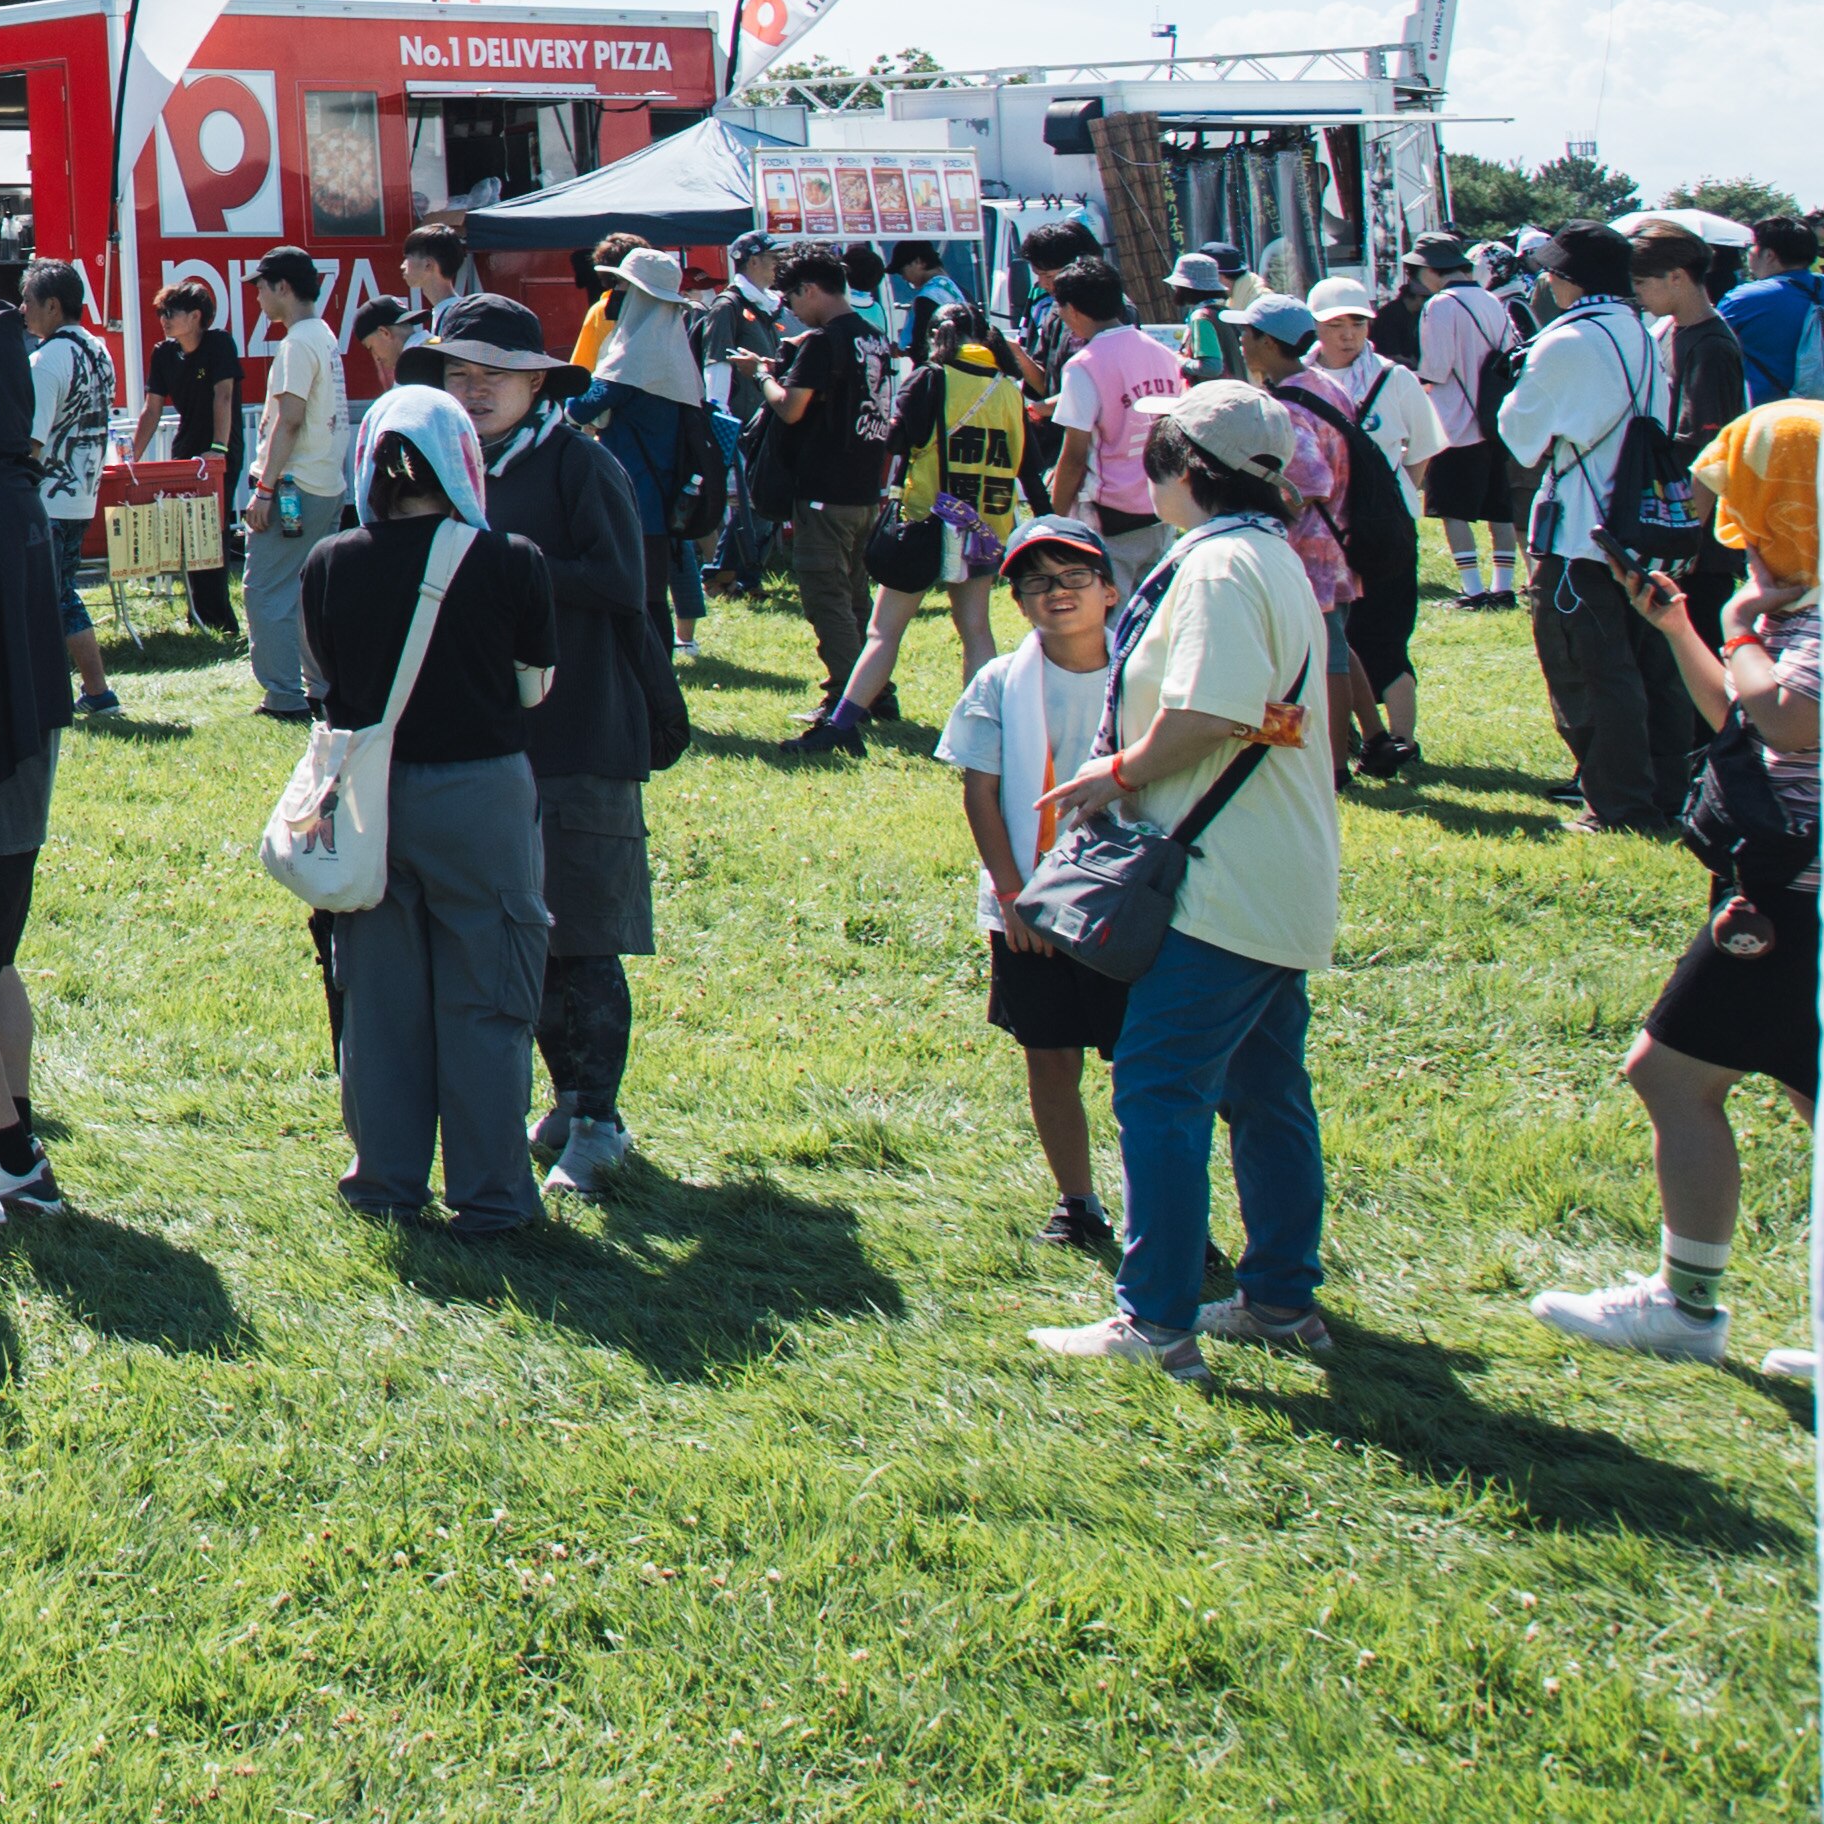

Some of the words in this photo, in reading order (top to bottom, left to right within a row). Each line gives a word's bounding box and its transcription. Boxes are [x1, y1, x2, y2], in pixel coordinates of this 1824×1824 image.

[399, 35, 461, 68] No.1
[467, 37, 589, 70] DELIVERY
[593, 40, 673, 72] PIZZA
